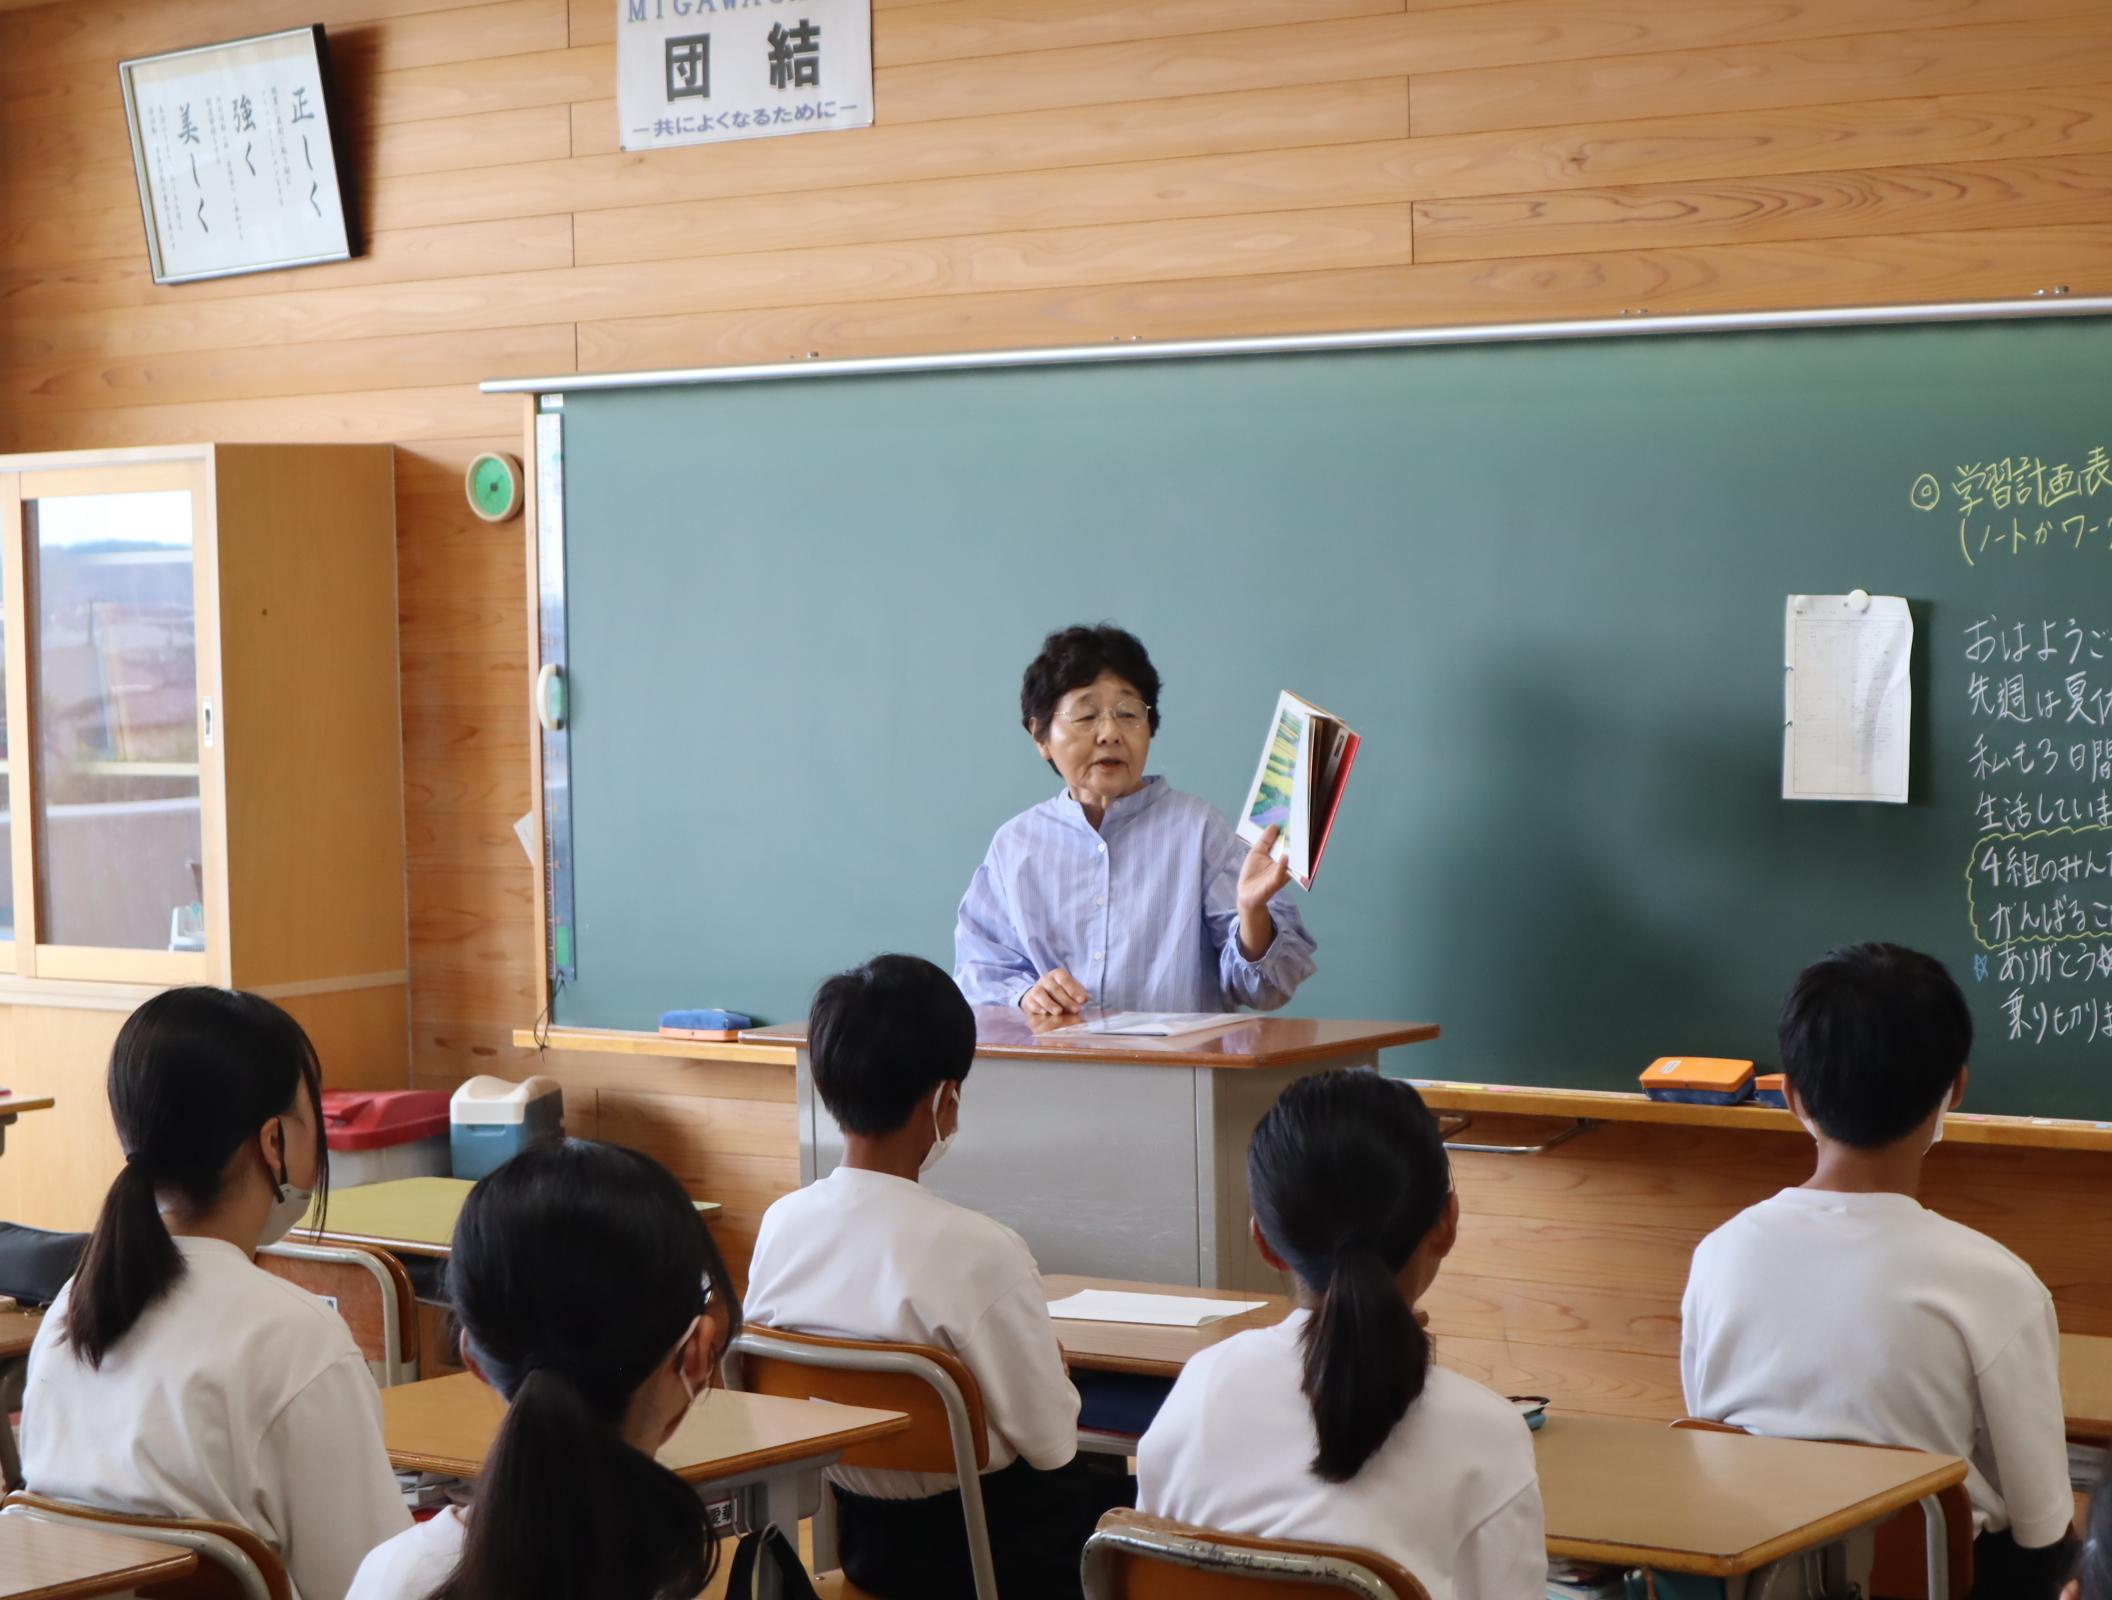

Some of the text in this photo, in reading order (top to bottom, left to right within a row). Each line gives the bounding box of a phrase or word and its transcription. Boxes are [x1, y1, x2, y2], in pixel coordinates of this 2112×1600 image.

[232, 94, 256, 177] 強く
[291, 87, 322, 218] 正しく
[178, 102, 209, 233] 美しく
[1952, 446, 2112, 516] 学習計画表
[1964, 613, 2112, 664] おはようご
[1975, 790, 2112, 832] 生活していま
[1981, 846, 2112, 888] 4組のみん
[1989, 894, 2112, 939] がんばるこ
[1998, 942, 2096, 984] ありがとう
